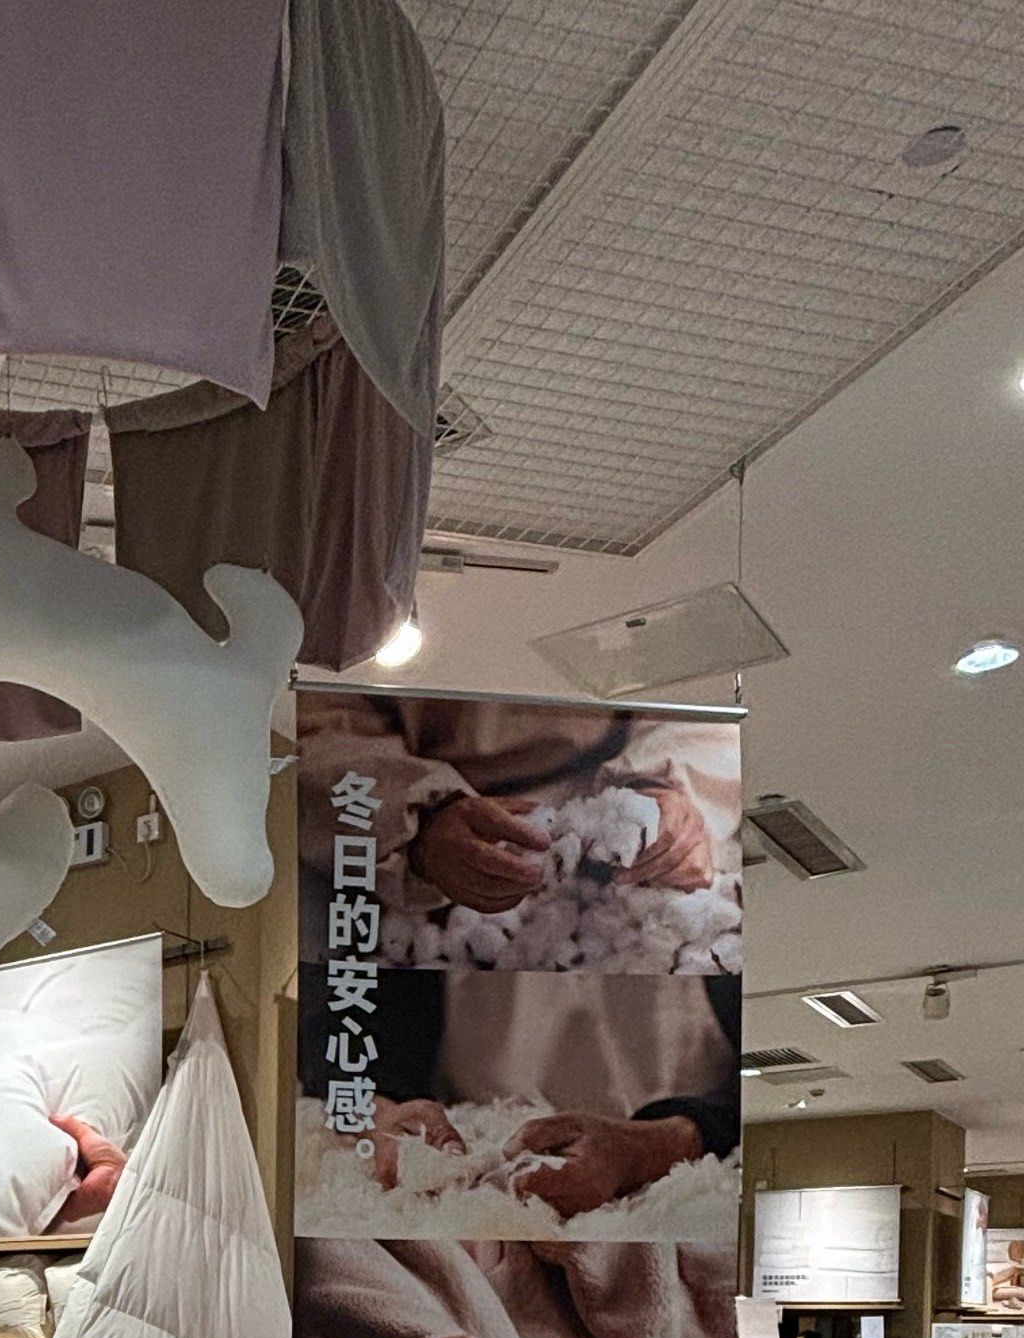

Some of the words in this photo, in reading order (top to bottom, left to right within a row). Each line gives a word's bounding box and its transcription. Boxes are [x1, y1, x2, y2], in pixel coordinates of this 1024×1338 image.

[323, 771, 383, 1160] 冬日的安心感。
